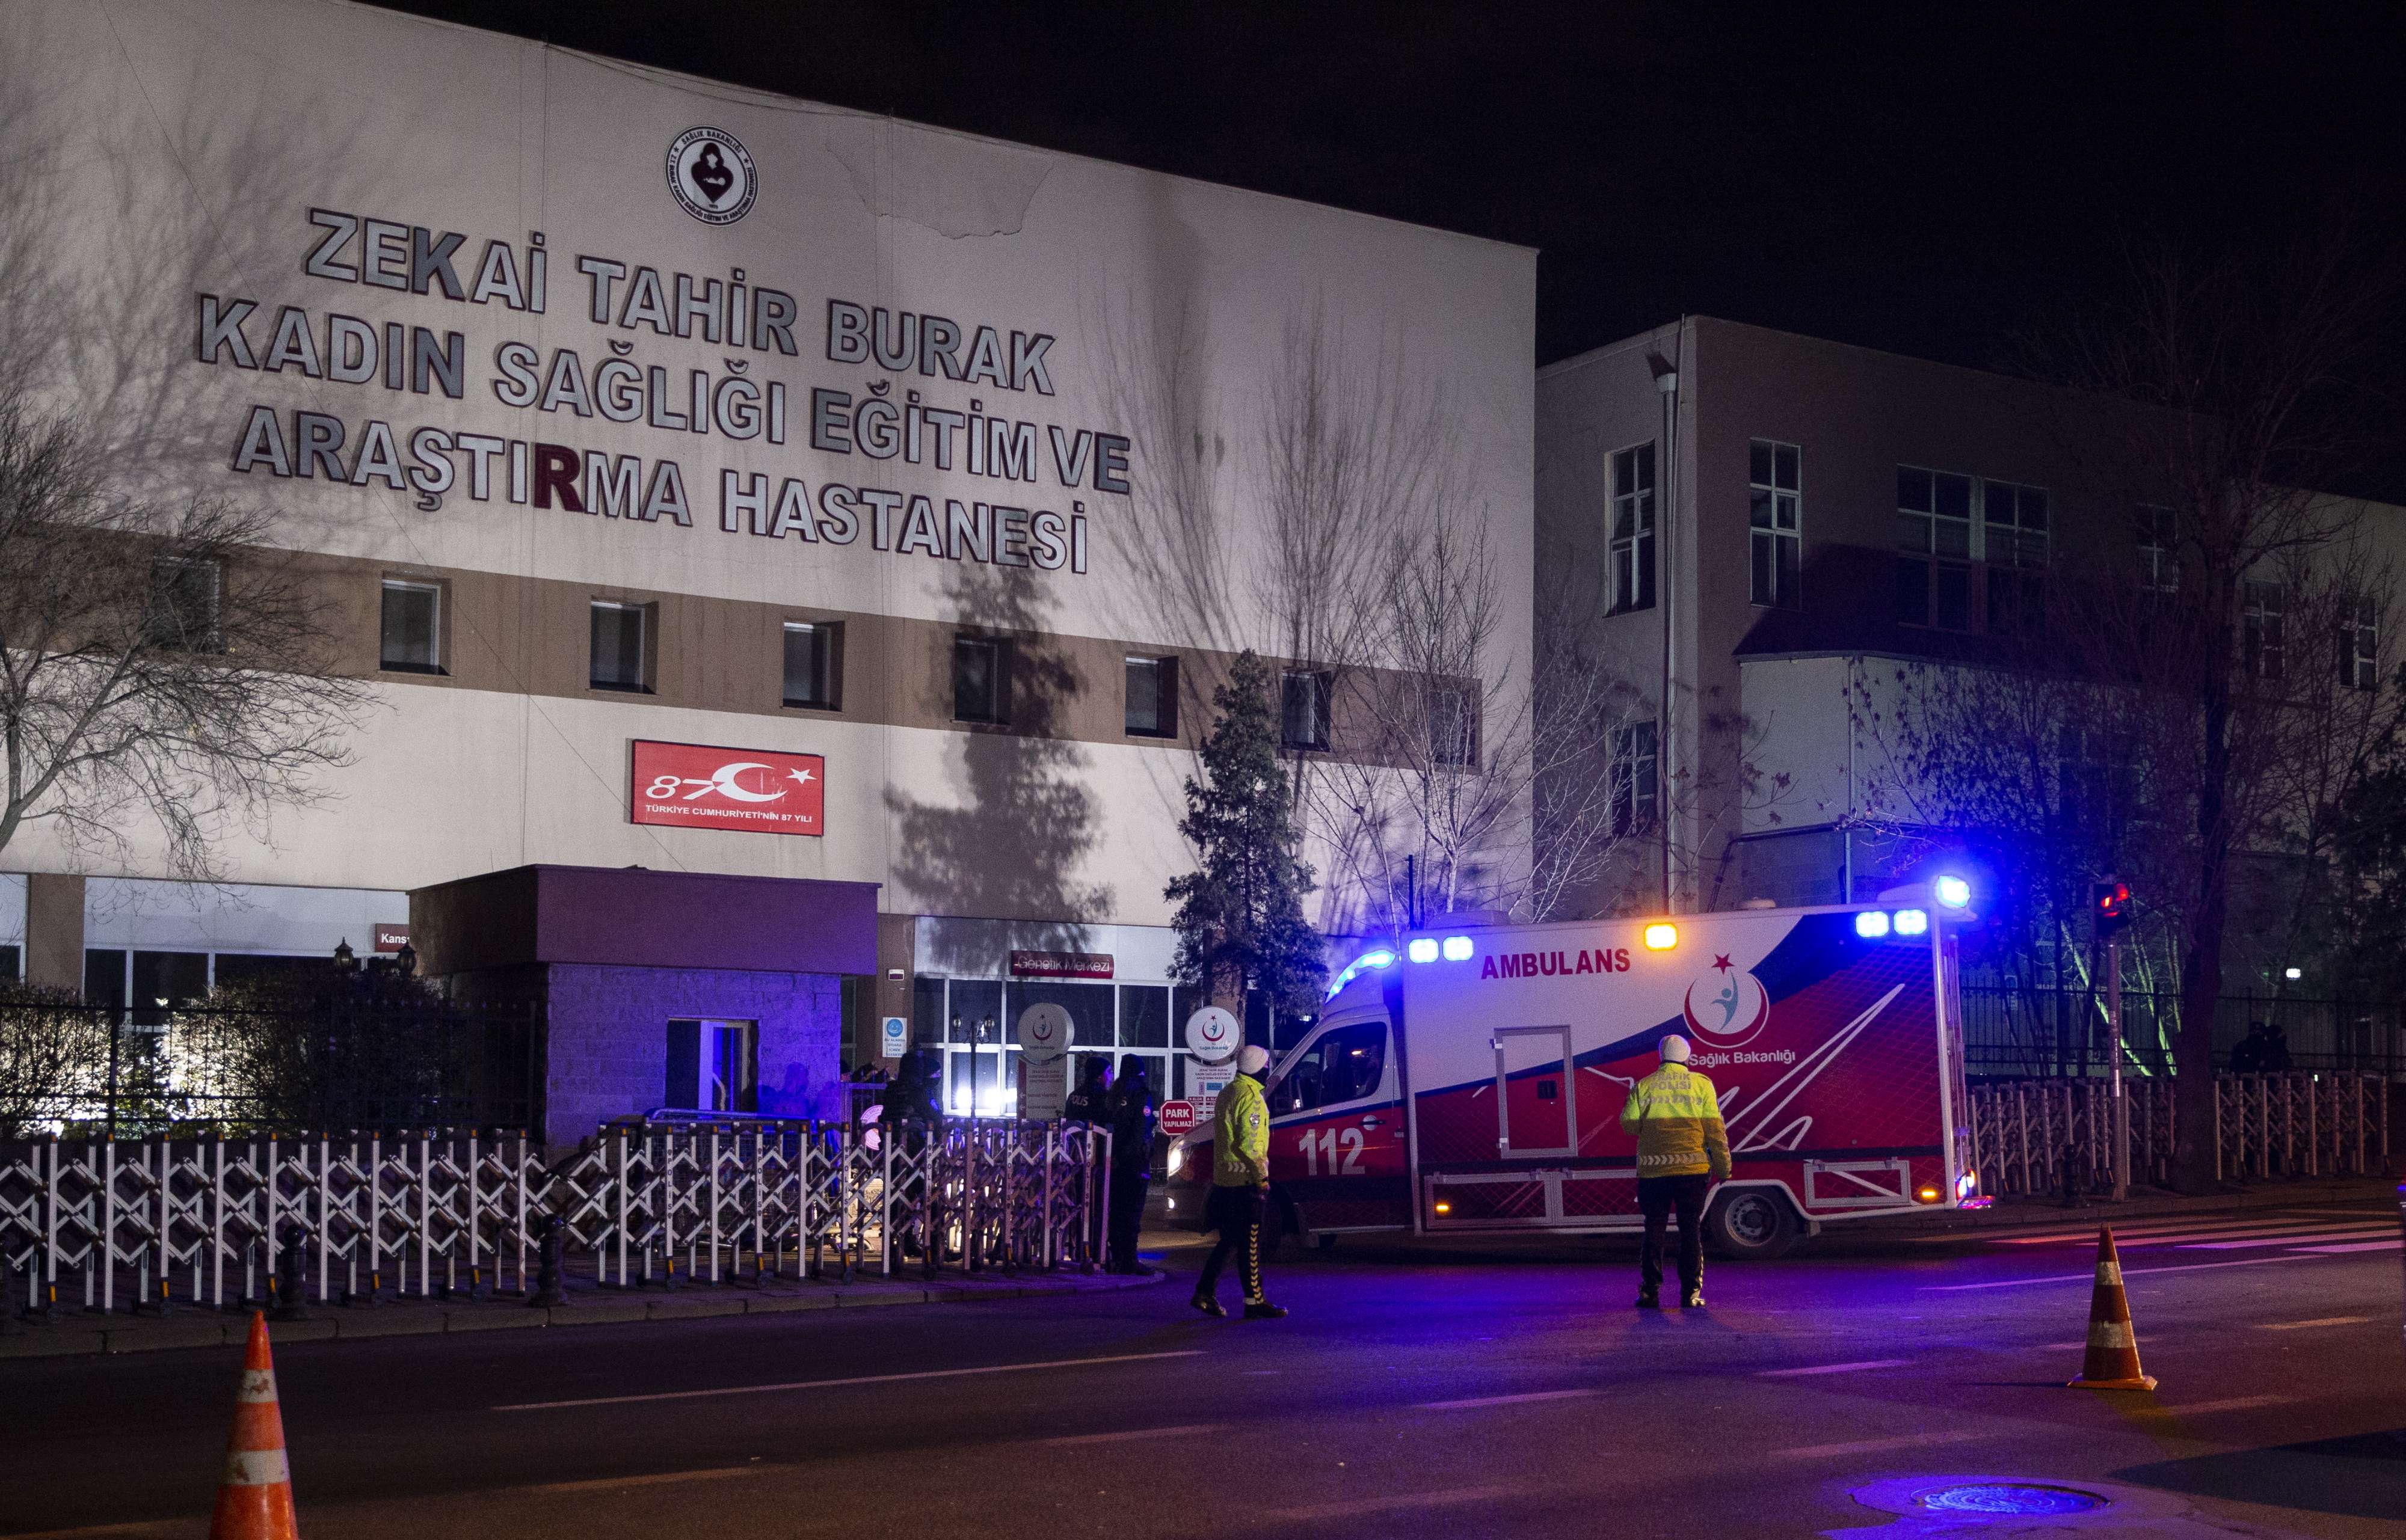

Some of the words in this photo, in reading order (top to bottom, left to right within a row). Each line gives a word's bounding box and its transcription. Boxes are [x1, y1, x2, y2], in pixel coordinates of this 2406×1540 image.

[707, 130, 742, 153] BAKANLIĞI
[305, 207, 547, 314] ZEKAİ
[577, 256, 798, 356] TAHİR
[826, 298, 1056, 396] BURAK
[198, 293, 464, 399] KADIN
[493, 339, 786, 446] SAĞLIĞI
[810, 379, 1036, 483] EĞİTİM
[1048, 425, 1131, 495] VE
[232, 406, 693, 527] ARAŞTIRMA
[720, 468, 1088, 574] HASTANESİ
[645, 775, 725, 800] 87
[645, 804, 690, 815] TÜRKİYE
[692, 808, 780, 821] CUMHURİYETİ'NİN
[794, 815, 812, 823] YILI
[381, 933, 410, 944] Kans
[1017, 955, 1063, 971] Genetik
[1064, 958, 1110, 972] Merkezi
[1480, 948, 1631, 980] AMBULANS
[1689, 1053, 1731, 1068] Sağlık
[1734, 1049, 1795, 1065] Bakanlığı
[1165, 1109, 1190, 1118] PARK
[1299, 1127, 1365, 1176] 112
